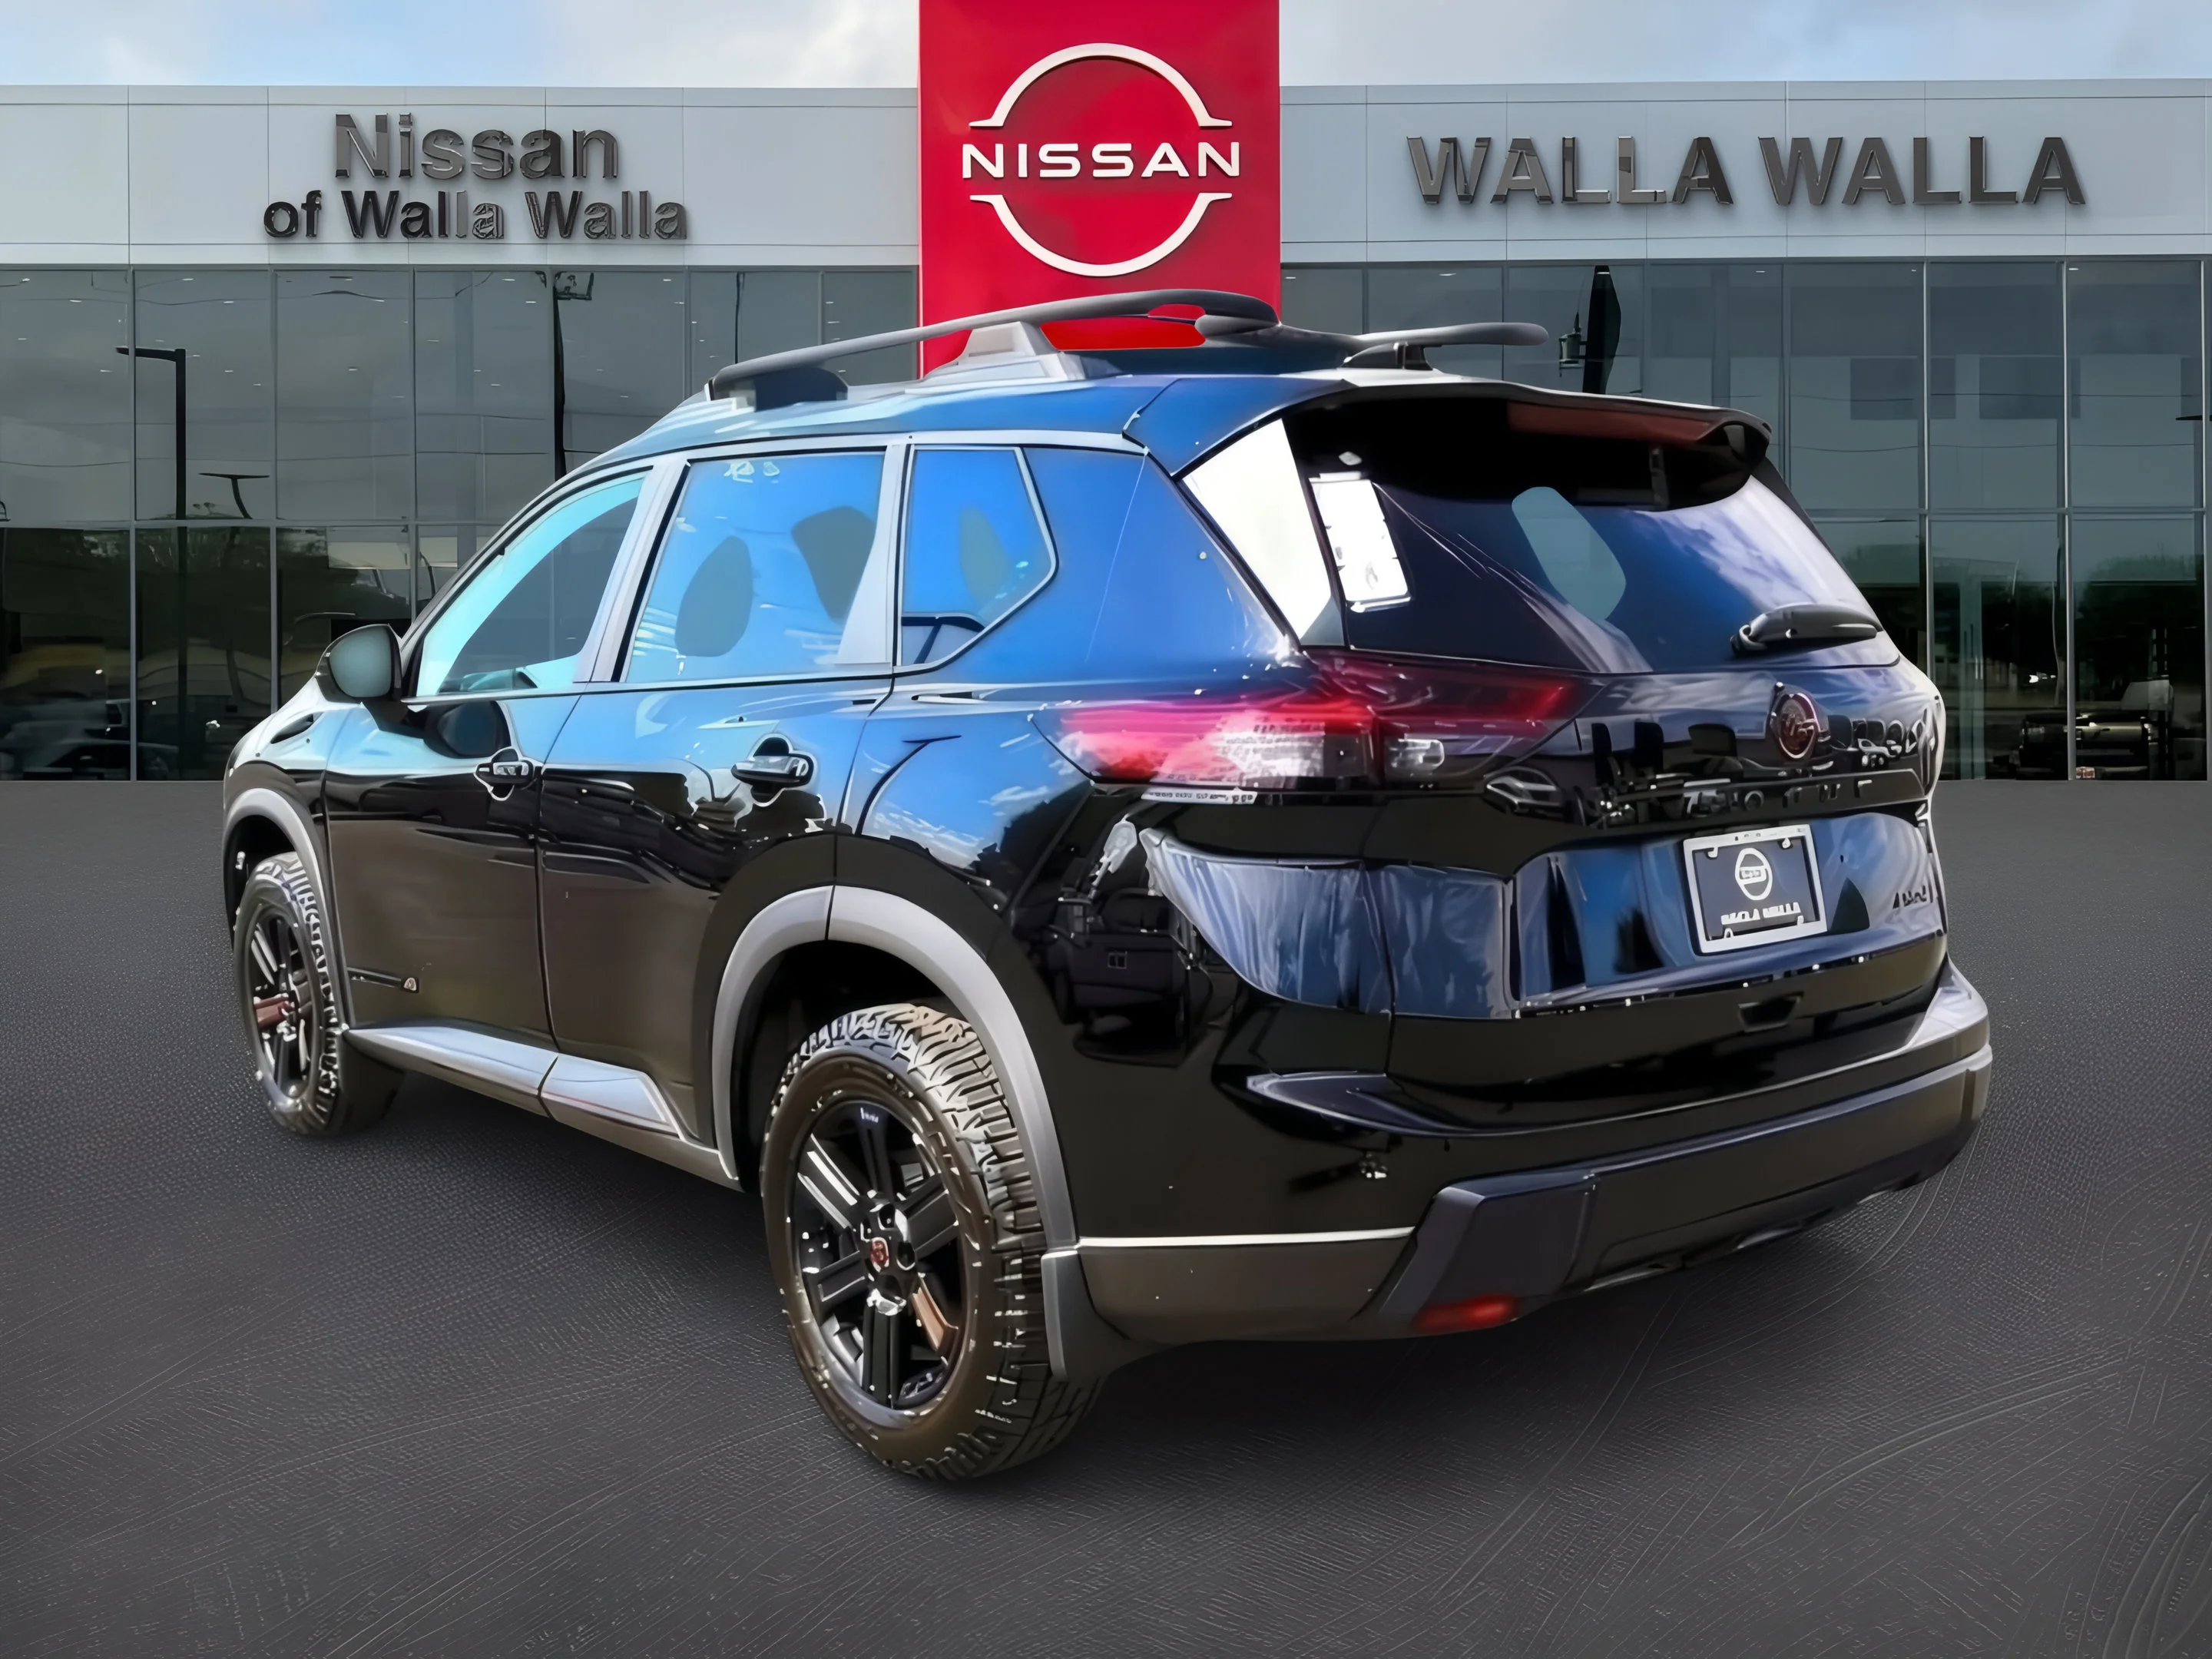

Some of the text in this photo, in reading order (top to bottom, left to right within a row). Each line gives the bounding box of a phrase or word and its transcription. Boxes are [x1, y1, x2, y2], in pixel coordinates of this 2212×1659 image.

[336, 112, 618, 180] Nissan
[962, 142, 1240, 178] NISSAN
[1406, 136, 2086, 205] WALLA WALLA
[263, 190, 687, 240] of Walla Walla
